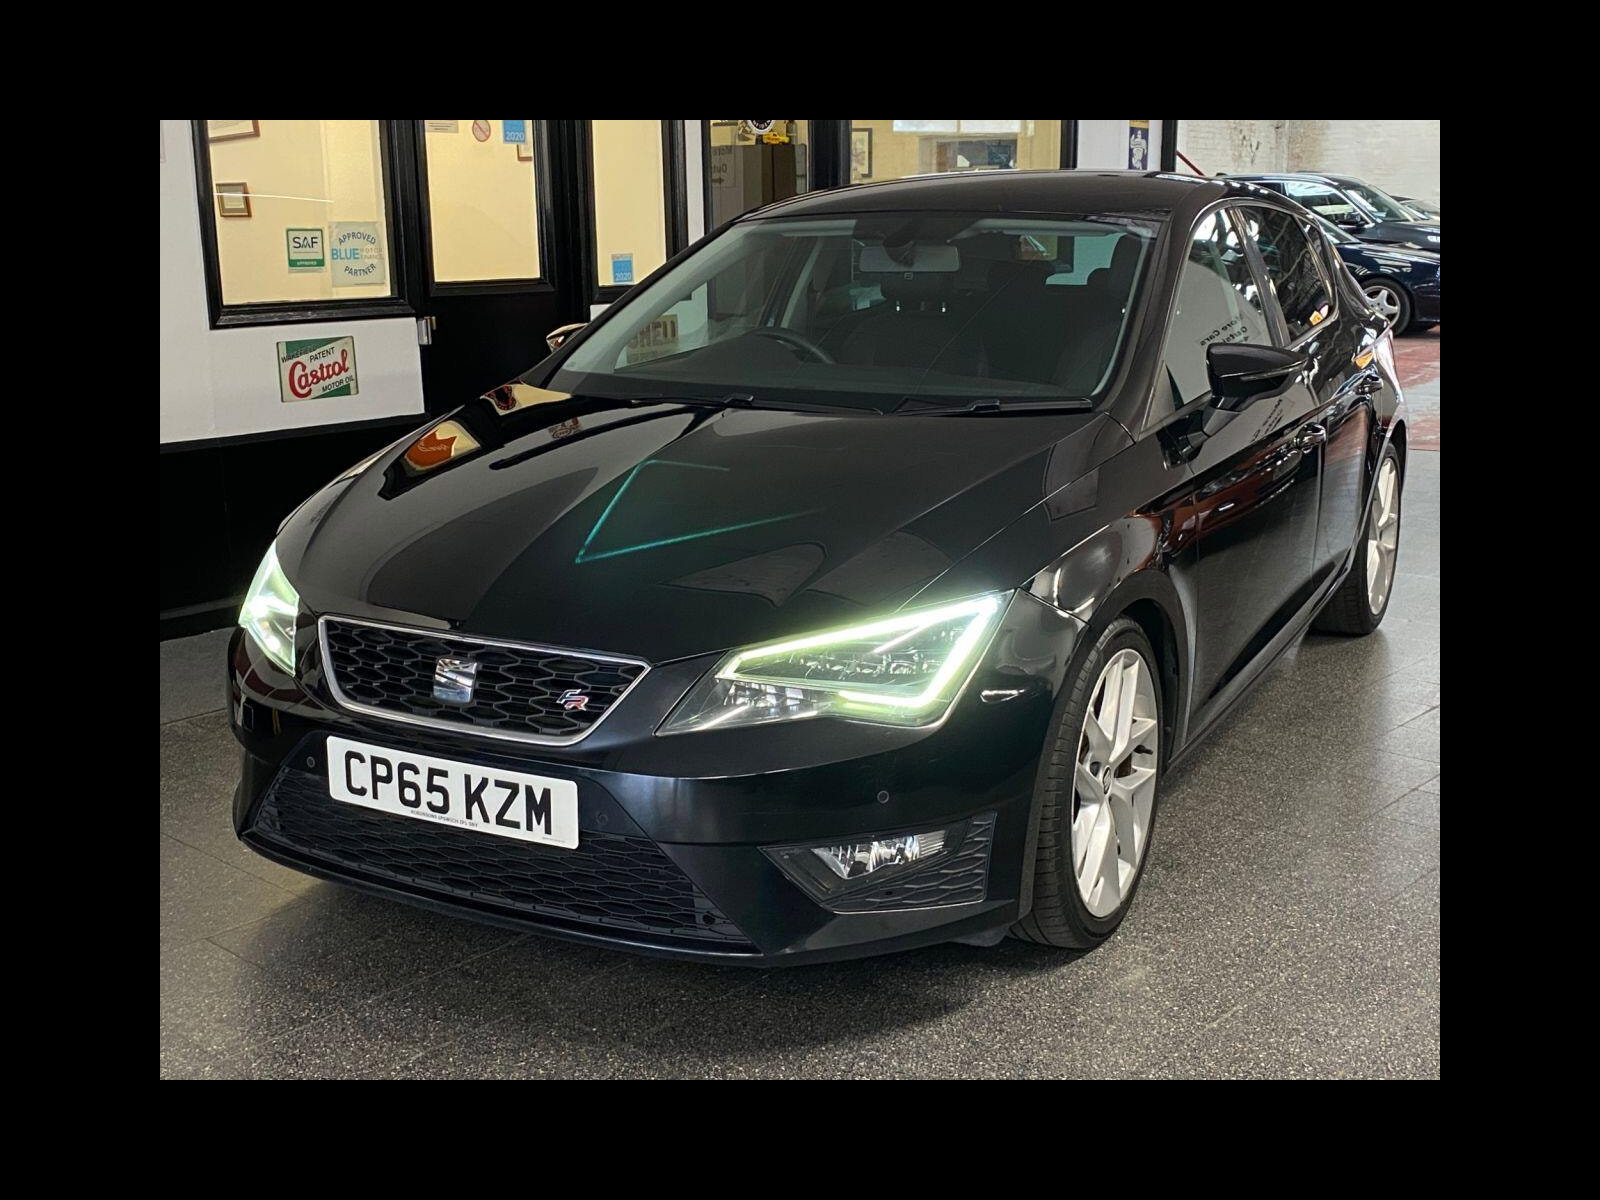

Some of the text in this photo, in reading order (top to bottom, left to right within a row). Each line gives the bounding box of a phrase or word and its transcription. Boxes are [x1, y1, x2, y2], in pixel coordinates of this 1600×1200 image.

[505, 131, 525, 140] 2020
[292, 236, 318, 249] SAF
[339, 232, 376, 245] APPROVED
[331, 248, 360, 260] BLUE
[344, 263, 376, 277] PARTNER
[309, 346, 335, 363] PATENT
[288, 348, 349, 398] Castrol
[322, 375, 354, 392] MOTOR OIL
[344, 750, 552, 836] CP65 KZM
